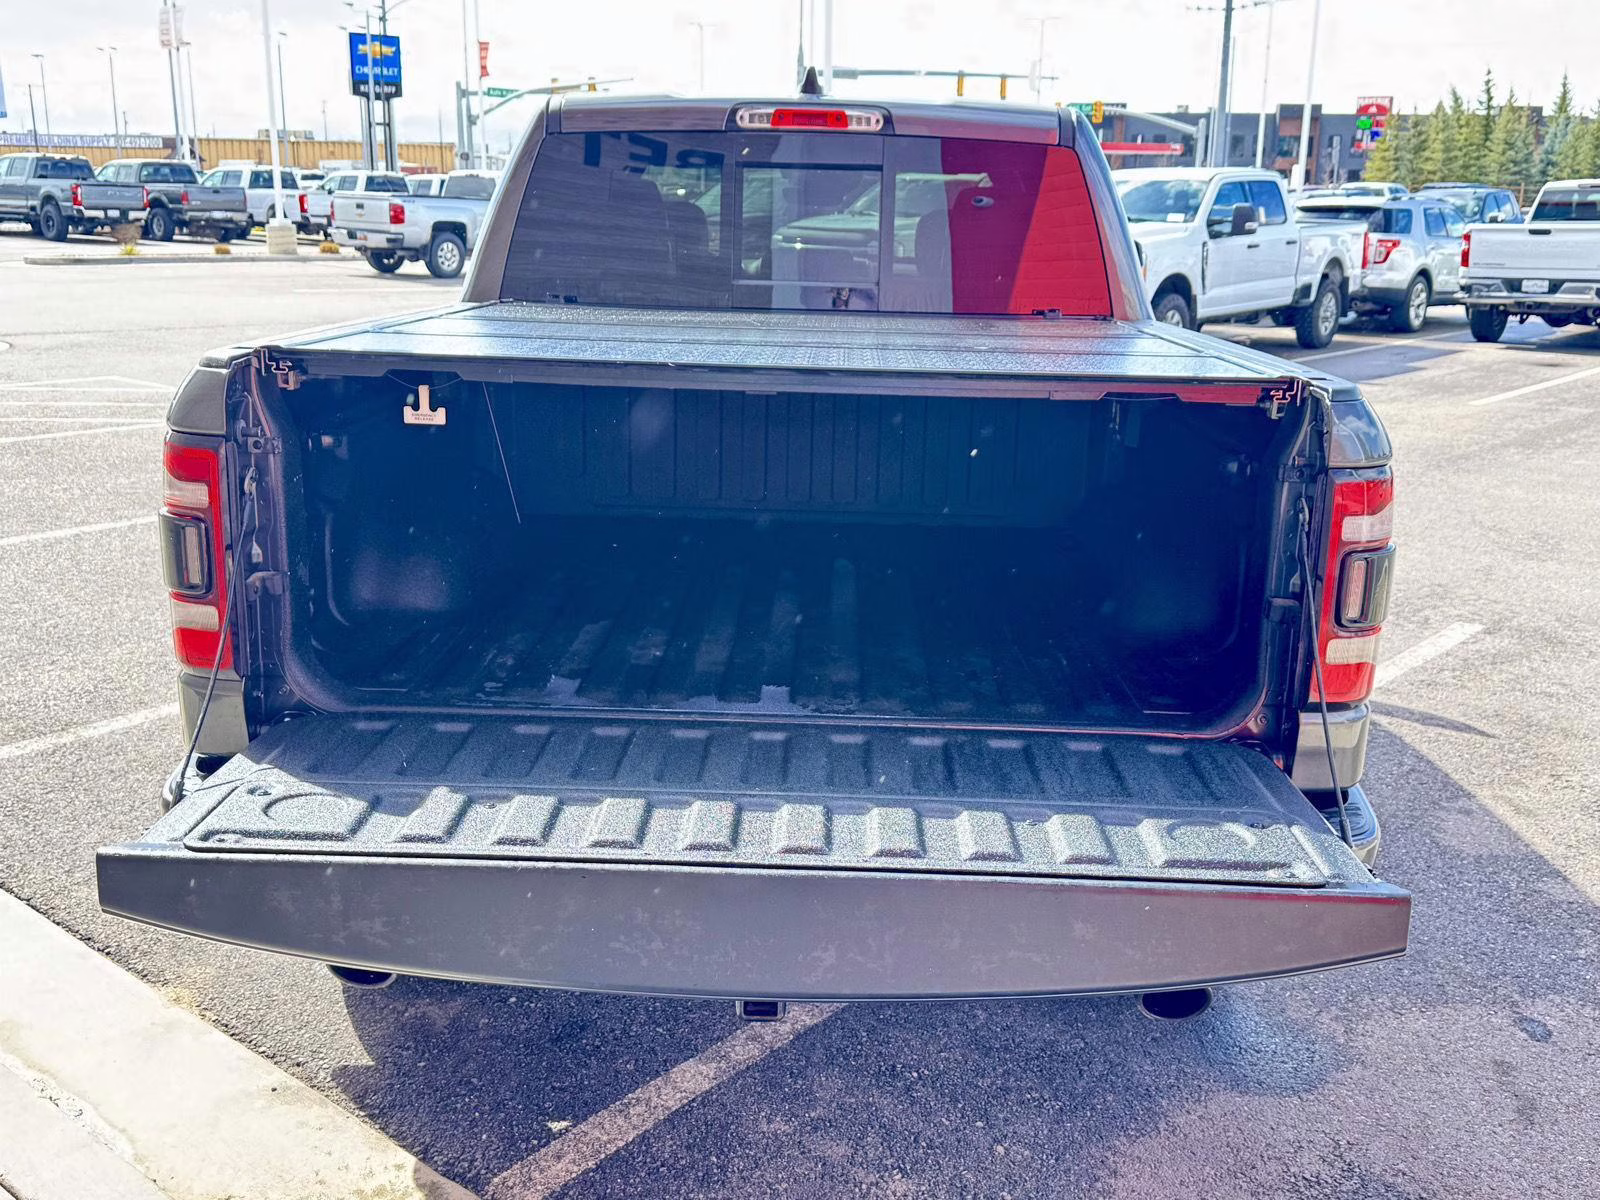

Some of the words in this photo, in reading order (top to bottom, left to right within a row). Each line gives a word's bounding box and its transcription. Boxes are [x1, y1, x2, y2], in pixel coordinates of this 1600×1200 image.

[355, 65, 398, 75] CHERLET
[38, 135, 78, 146] BUILDING
[80, 136, 111, 147] SUPPLY
